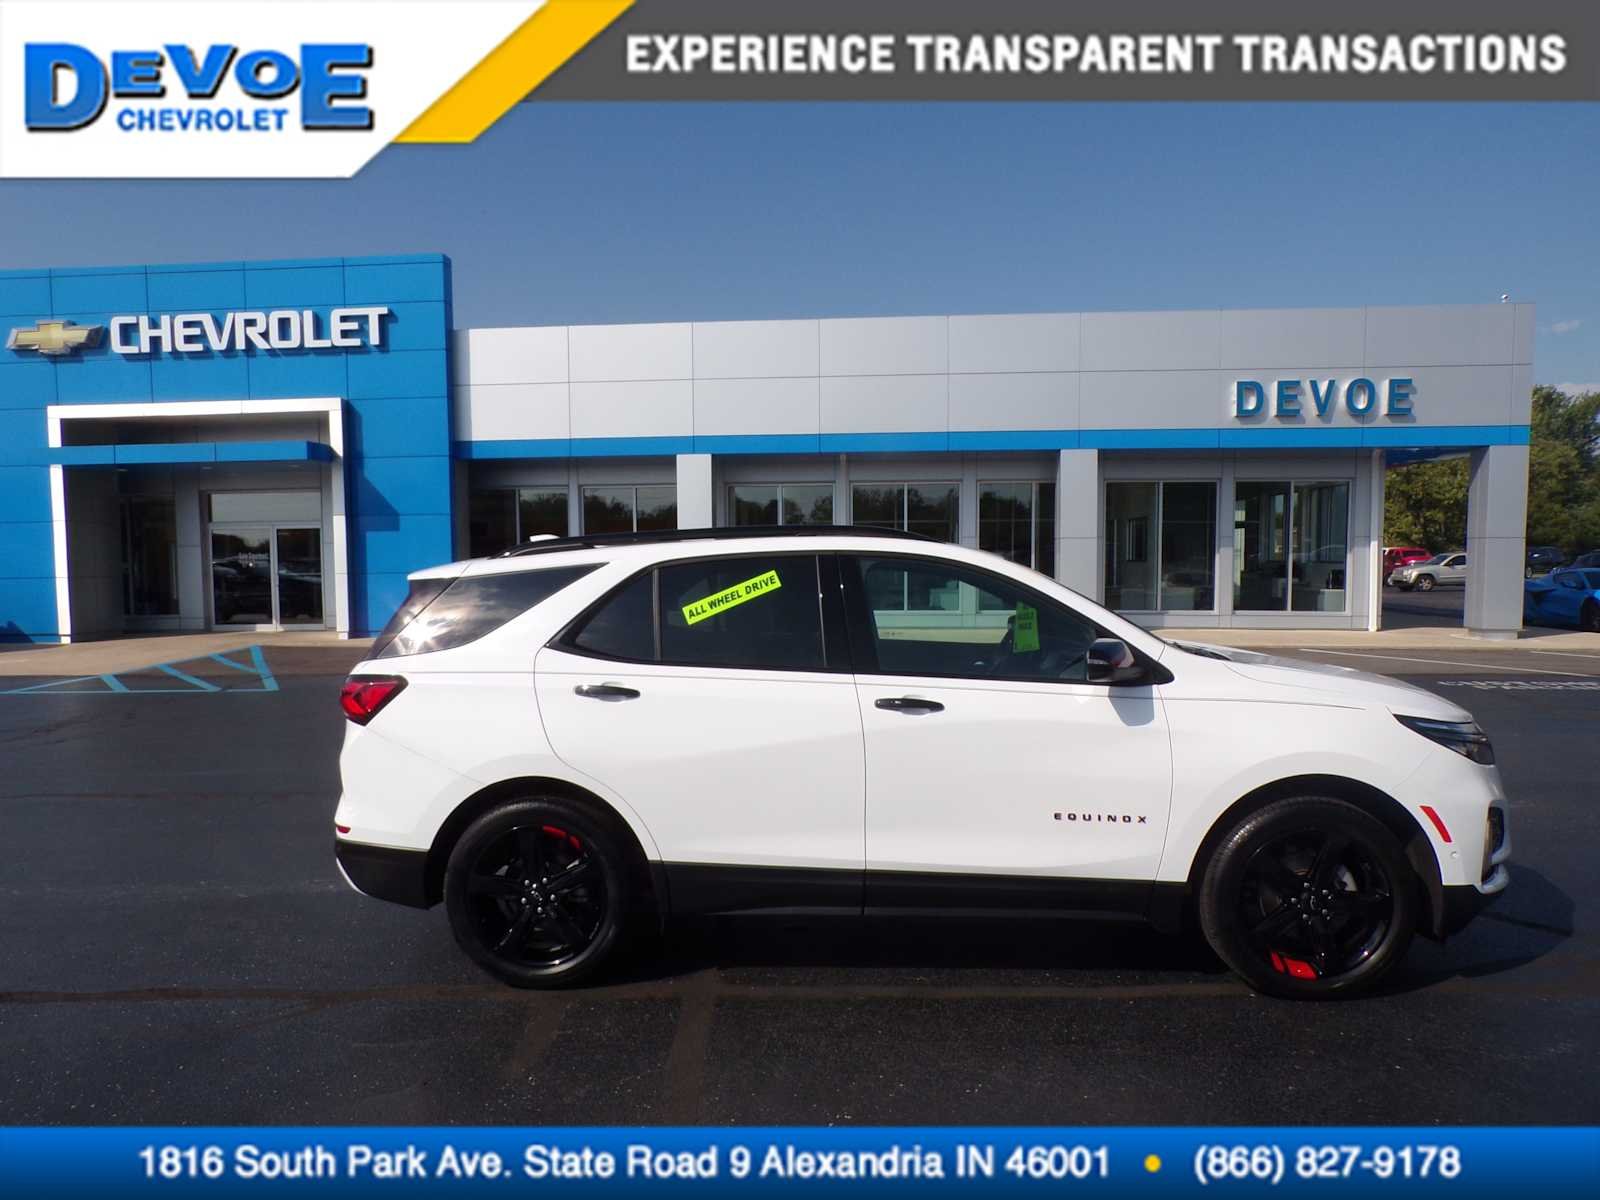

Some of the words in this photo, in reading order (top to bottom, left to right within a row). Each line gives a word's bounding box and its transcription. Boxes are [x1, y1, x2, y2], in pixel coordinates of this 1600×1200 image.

[109, 306, 389, 355] CHEVROLET
[1235, 377, 1414, 418] DEVOE
[688, 604, 708, 619] ALL
[707, 589, 743, 610] WHEEL
[745, 575, 777, 595] DRIVE
[1053, 812, 1147, 824] EQUINOX
